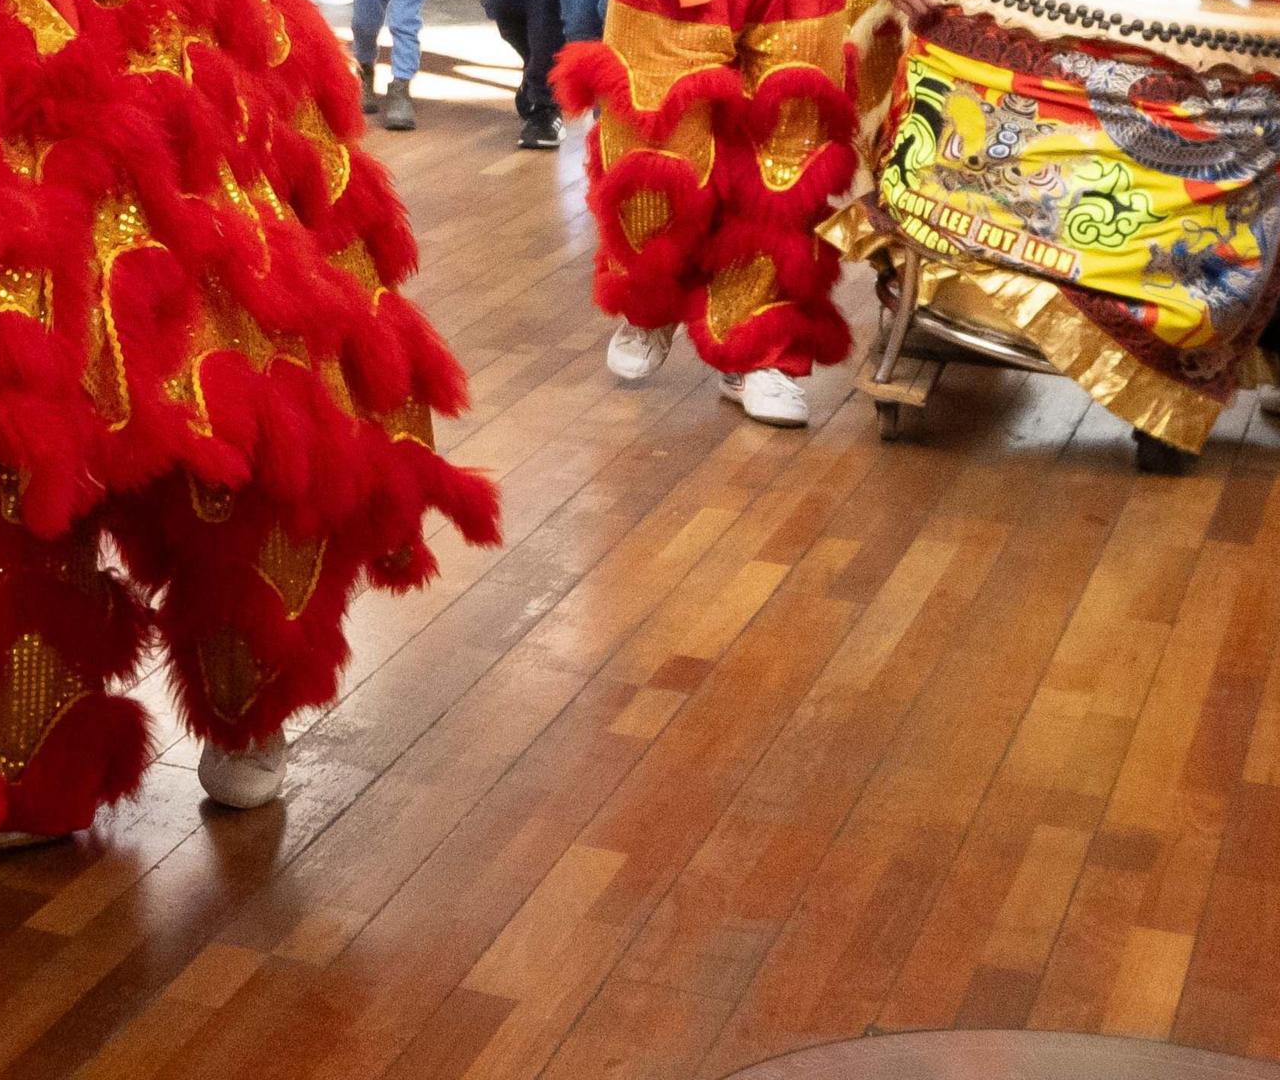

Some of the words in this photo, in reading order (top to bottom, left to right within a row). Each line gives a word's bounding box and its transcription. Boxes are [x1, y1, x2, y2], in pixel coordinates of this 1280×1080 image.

[938, 207, 972, 236] LEE
[976, 221, 1017, 252] FUT
[1023, 240, 1074, 274] LION
